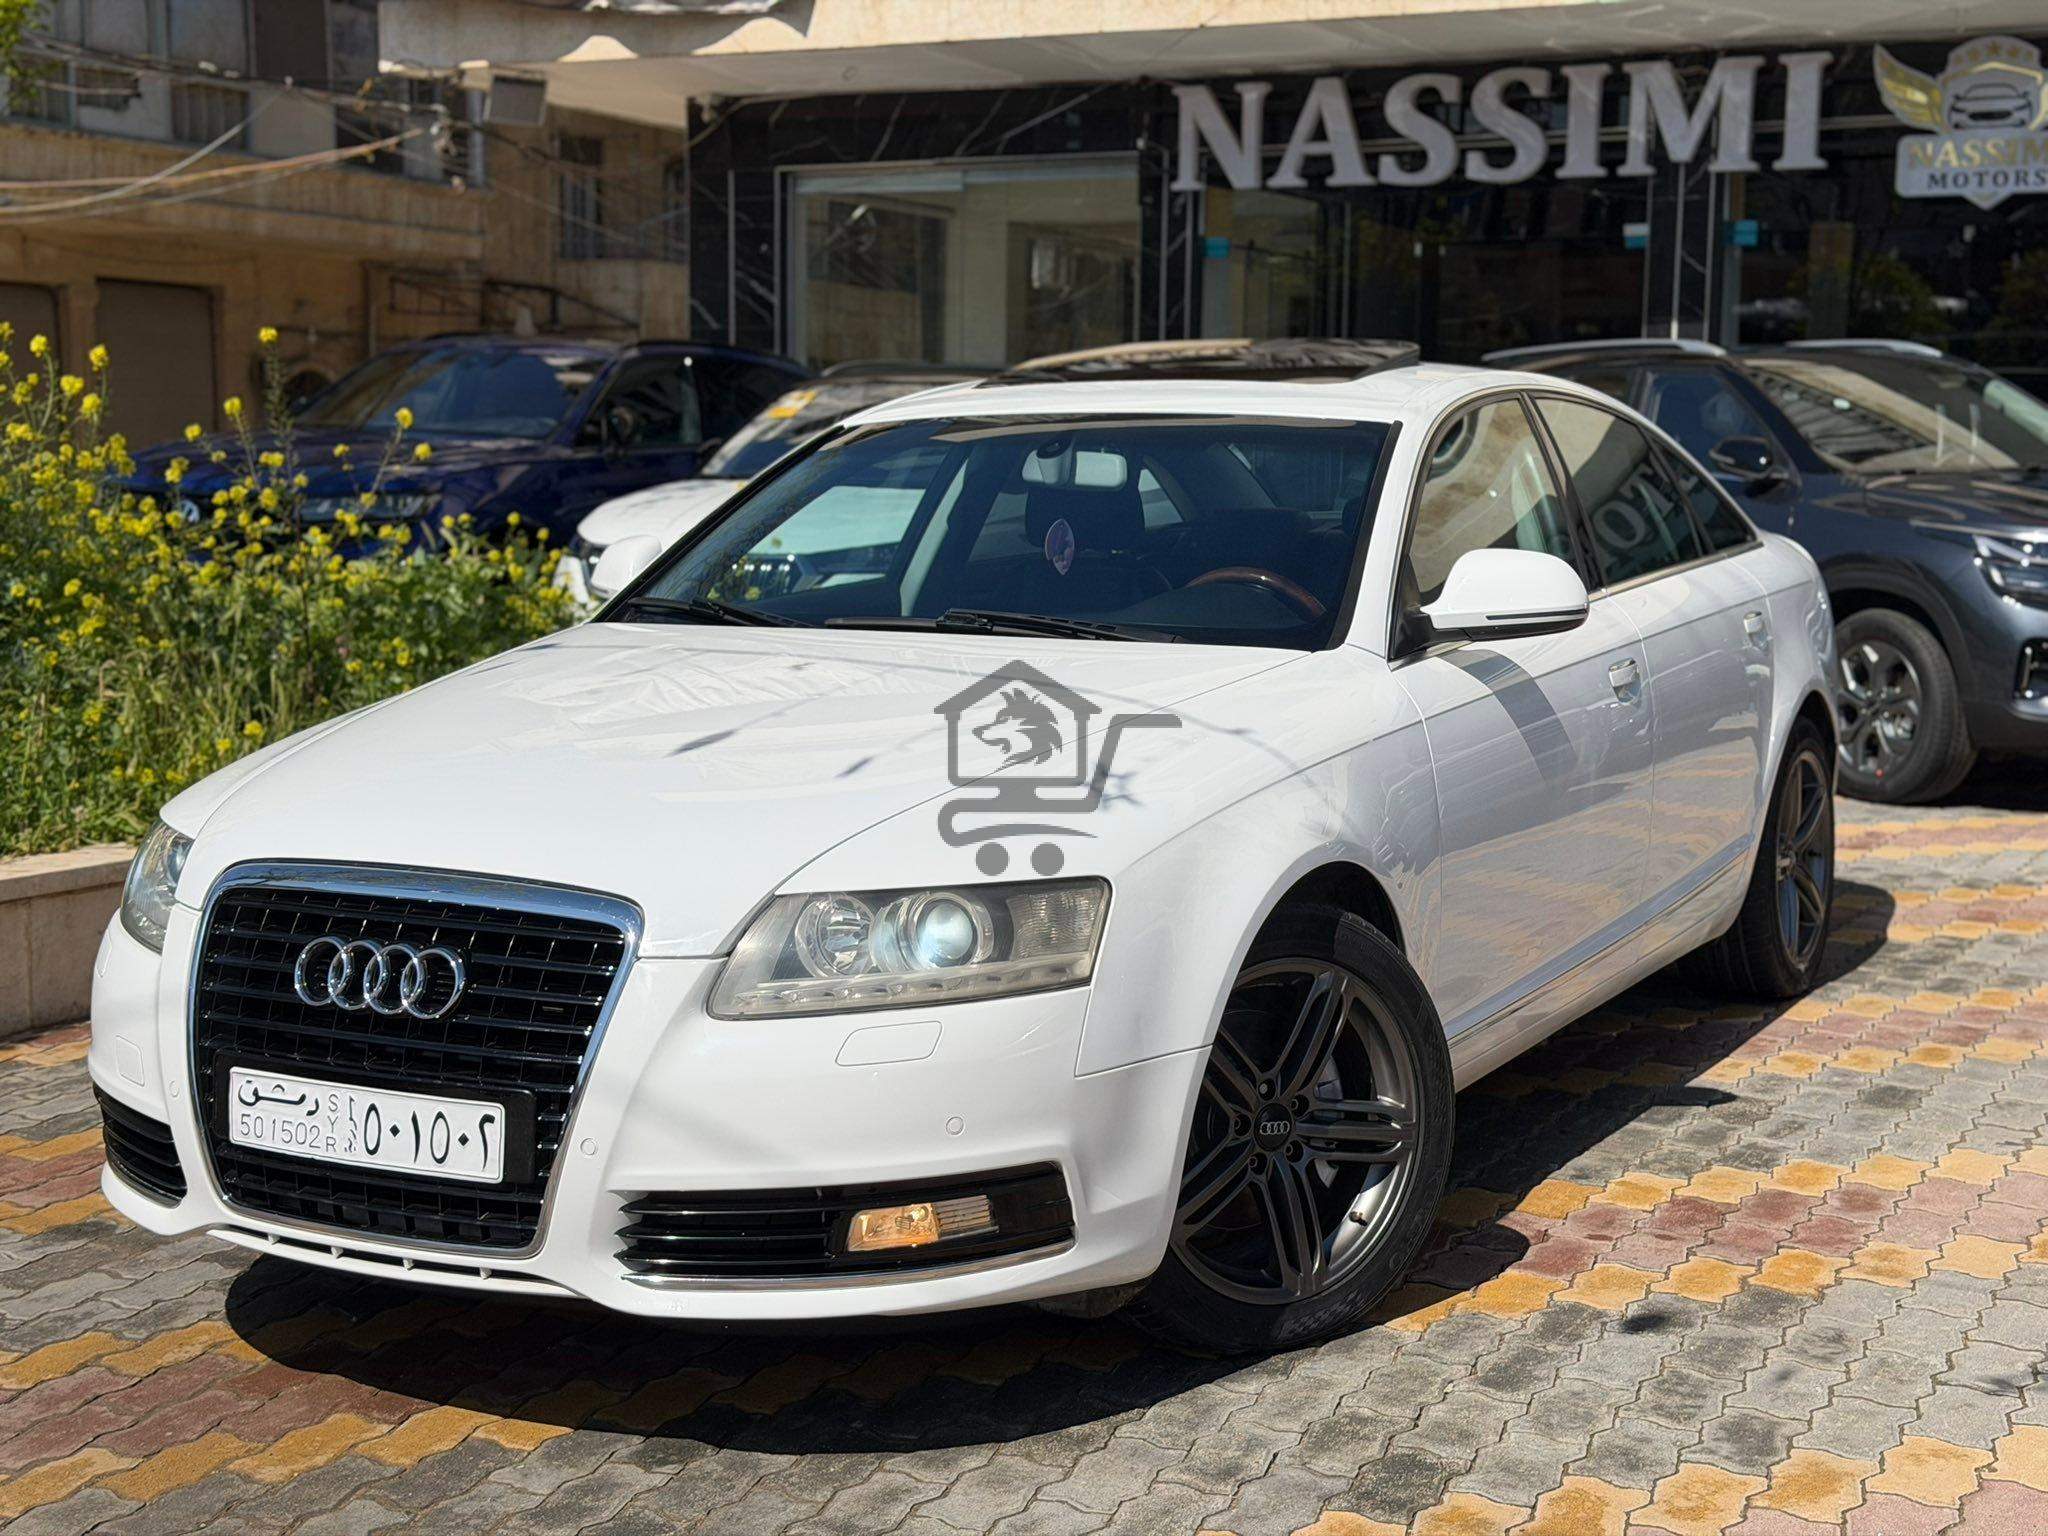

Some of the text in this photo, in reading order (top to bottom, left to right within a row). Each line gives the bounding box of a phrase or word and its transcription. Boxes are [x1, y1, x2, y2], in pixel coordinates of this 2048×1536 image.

[1170, 49, 1834, 192] NASSIMI
[1927, 168, 2047, 189] MOTORS
[240, 1113, 321, 1149] 501502
[363, 1102, 496, 1173] ٥٠١٥٠٢
